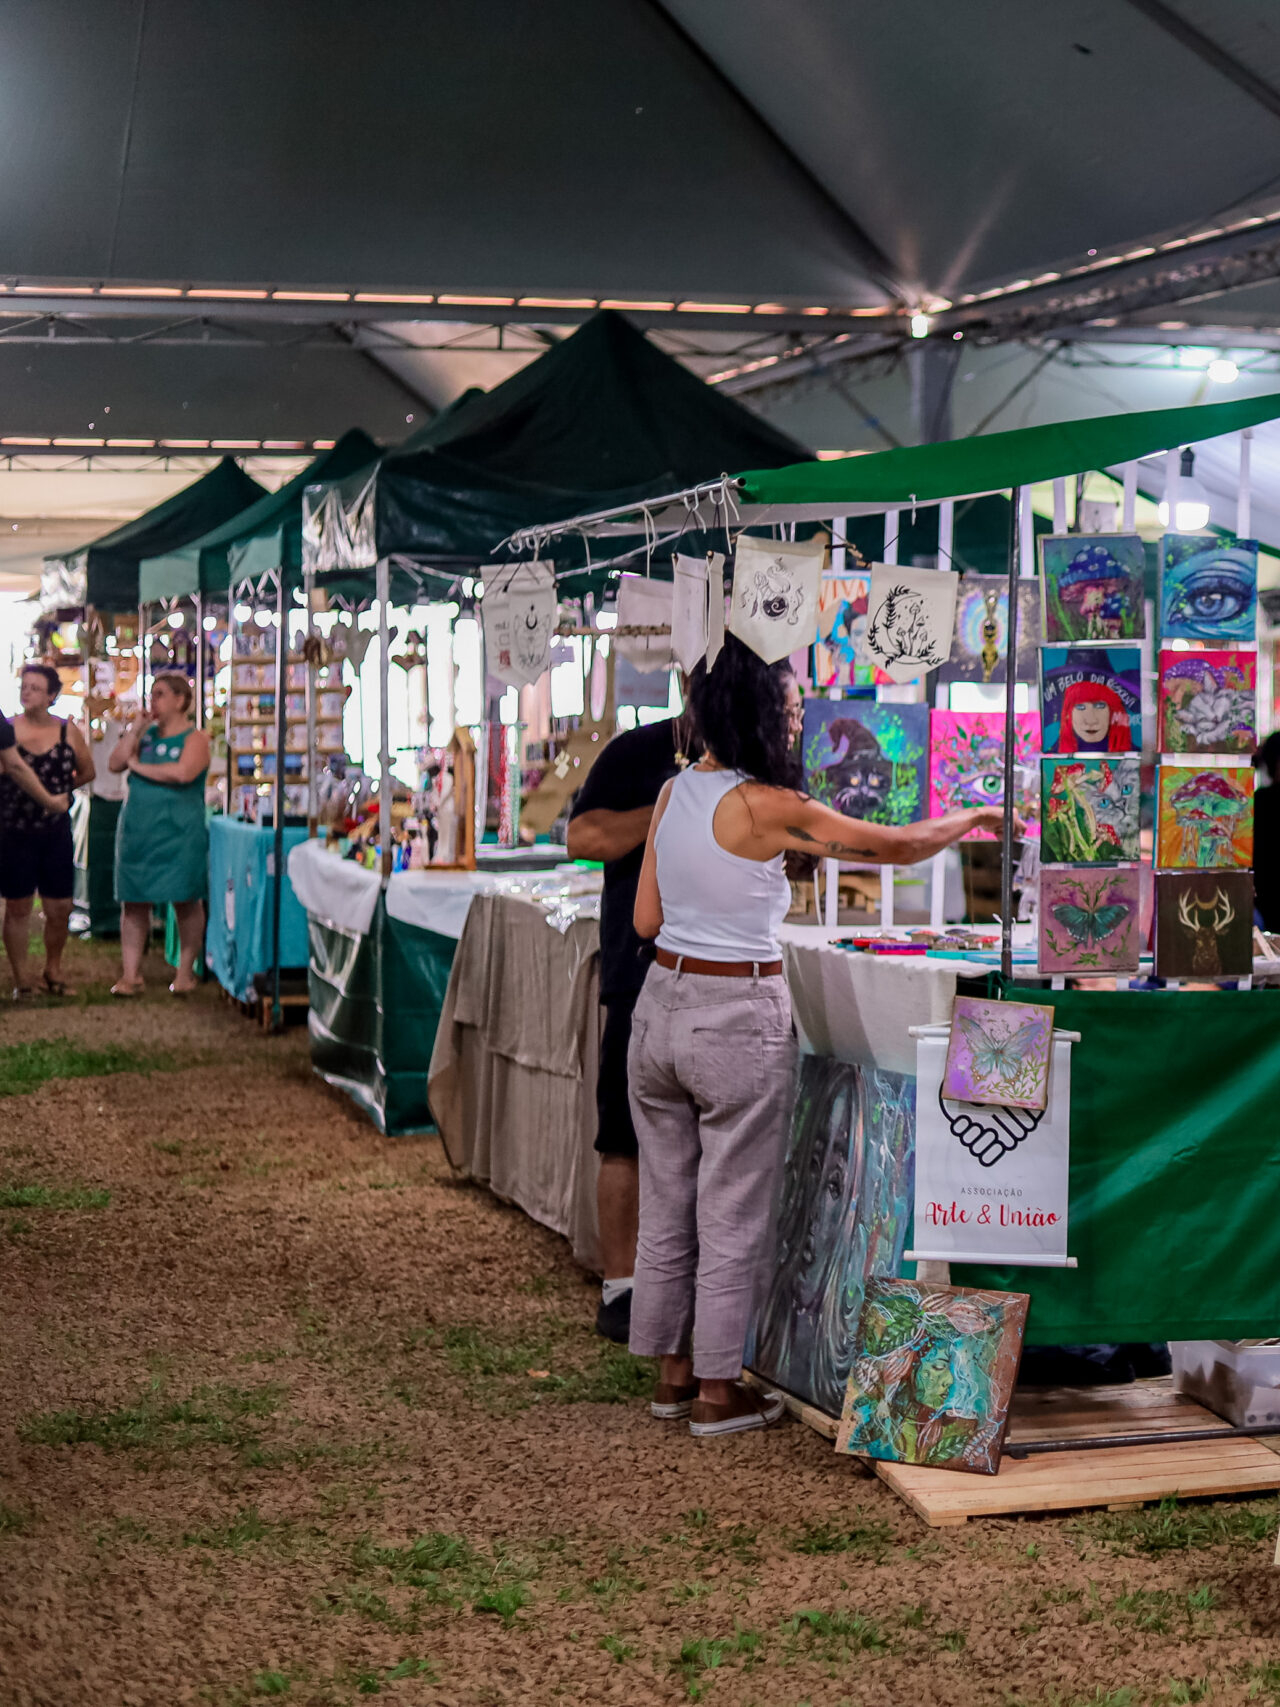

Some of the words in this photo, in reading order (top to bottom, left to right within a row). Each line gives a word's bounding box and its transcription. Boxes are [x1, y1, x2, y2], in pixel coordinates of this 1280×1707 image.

[1057, 671, 1083, 692] BELO
[961, 1187, 1023, 1198] ASSOCIAÇÃO
[924, 1201, 974, 1226] Arte
[977, 1204, 991, 1224] &
[1000, 1203, 1061, 1227] União
